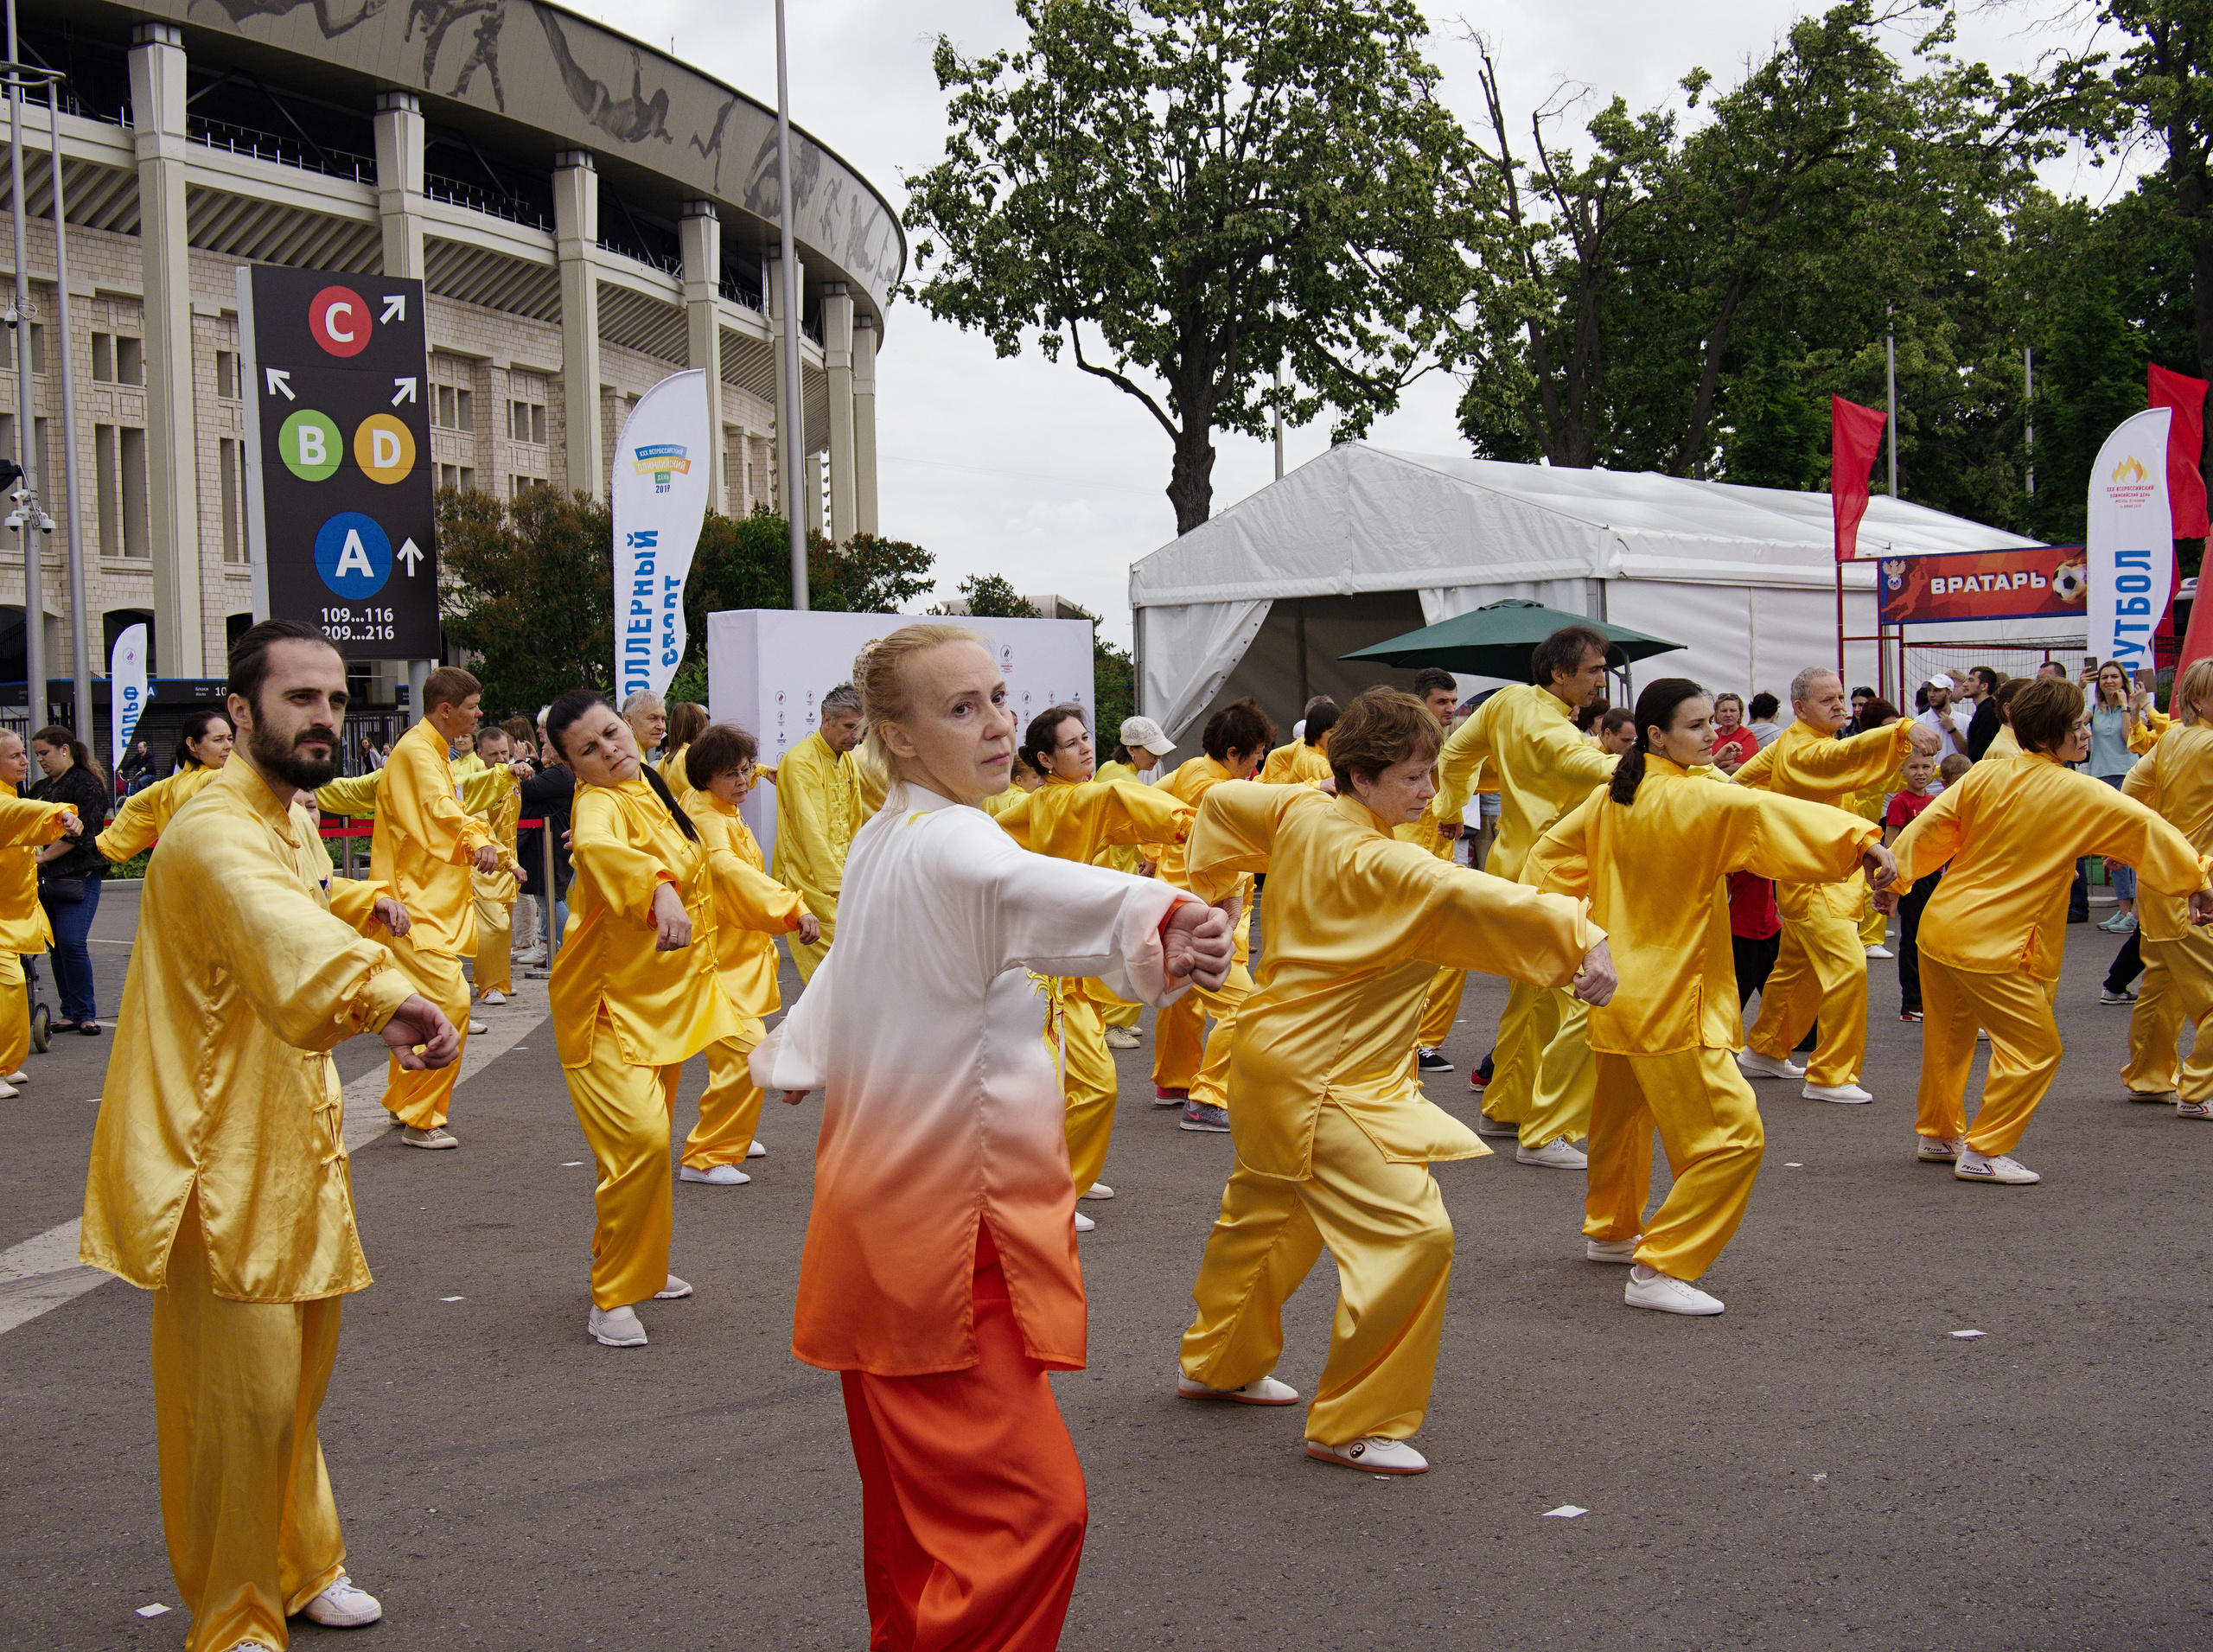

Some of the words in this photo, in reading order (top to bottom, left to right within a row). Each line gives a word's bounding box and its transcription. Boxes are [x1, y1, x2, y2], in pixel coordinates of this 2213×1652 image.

[325, 302, 354, 342] C
[298, 425, 327, 466] B
[372, 429, 401, 469] D
[637, 459, 686, 471] ОЛИМПИЙСКИЙ
[655, 484, 670, 493] 2019
[335, 529, 374, 577] A
[1930, 571, 2047, 595] ВРАТАРЬ
[321, 608, 394, 622] 109...116
[625, 531, 659, 697] ОЛЛЕРНЫЙ
